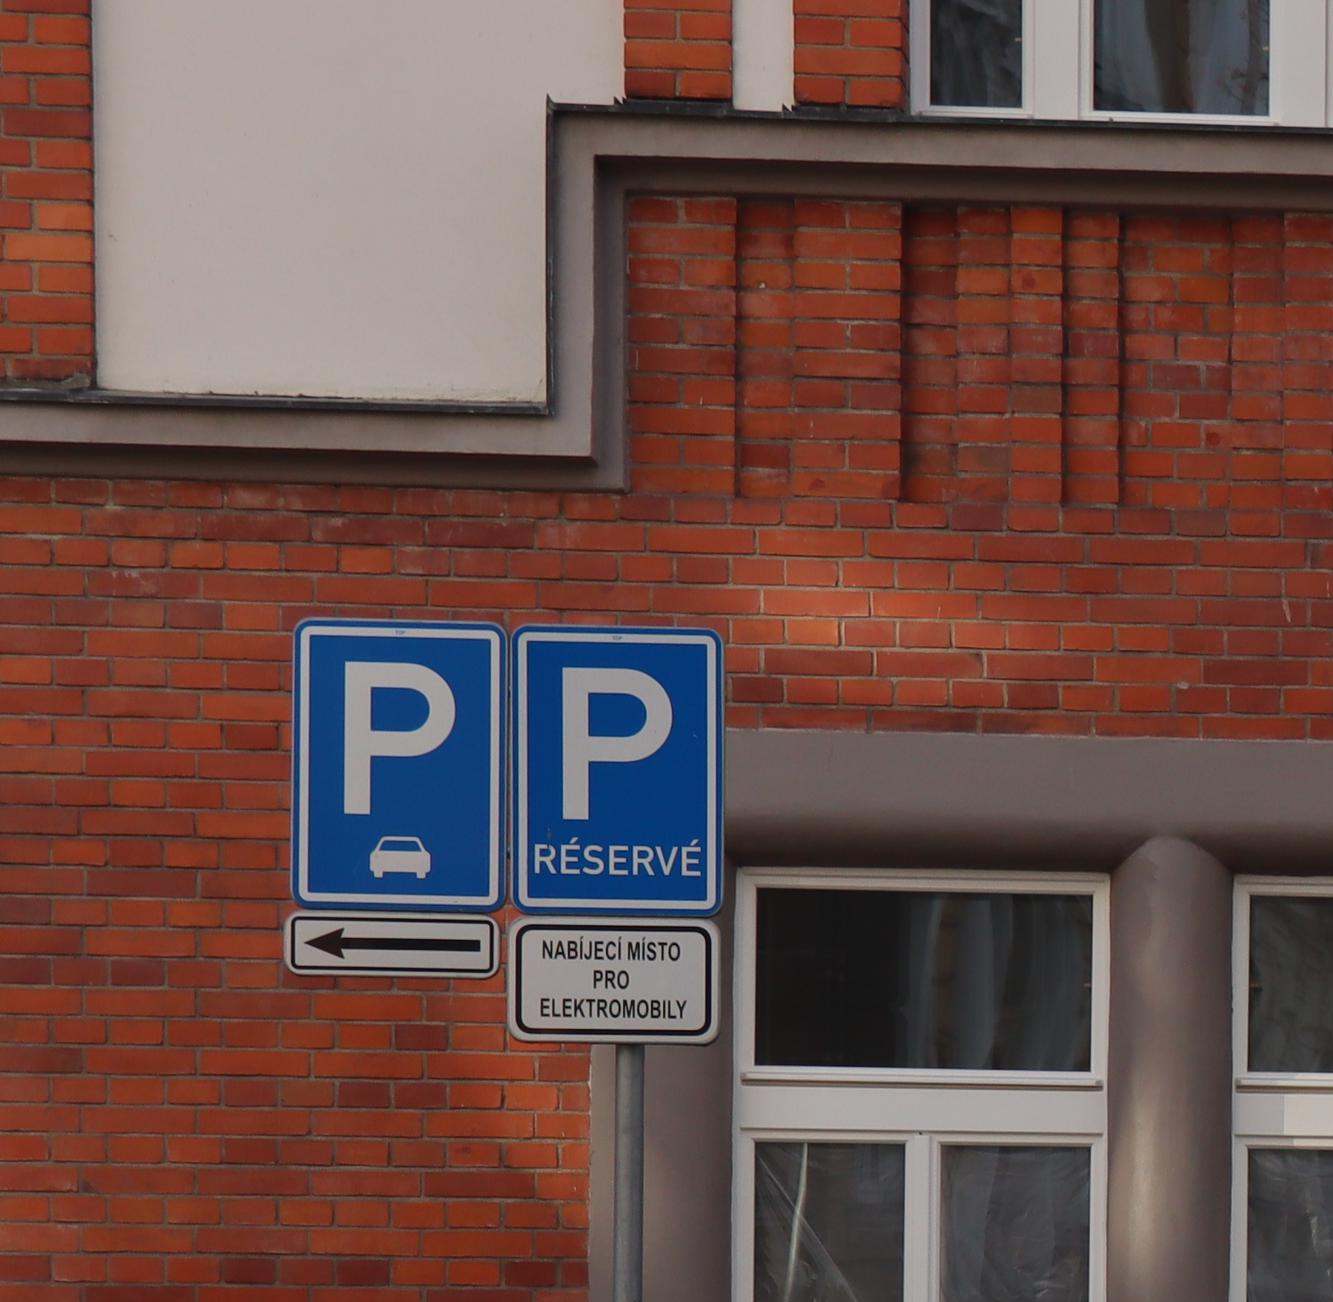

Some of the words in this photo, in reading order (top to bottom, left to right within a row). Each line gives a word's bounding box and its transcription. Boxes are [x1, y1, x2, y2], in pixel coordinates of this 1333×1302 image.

[343, 661, 456, 815] P
[562, 667, 673, 821] P
[534, 838, 702, 878] RÉSERVÉ
[542, 936, 623, 961] NABÍJECÍ
[627, 936, 681, 961] MÍSTO
[592, 970, 629, 990] PRO
[539, 998, 687, 1020] ELEKTROMOBILY
